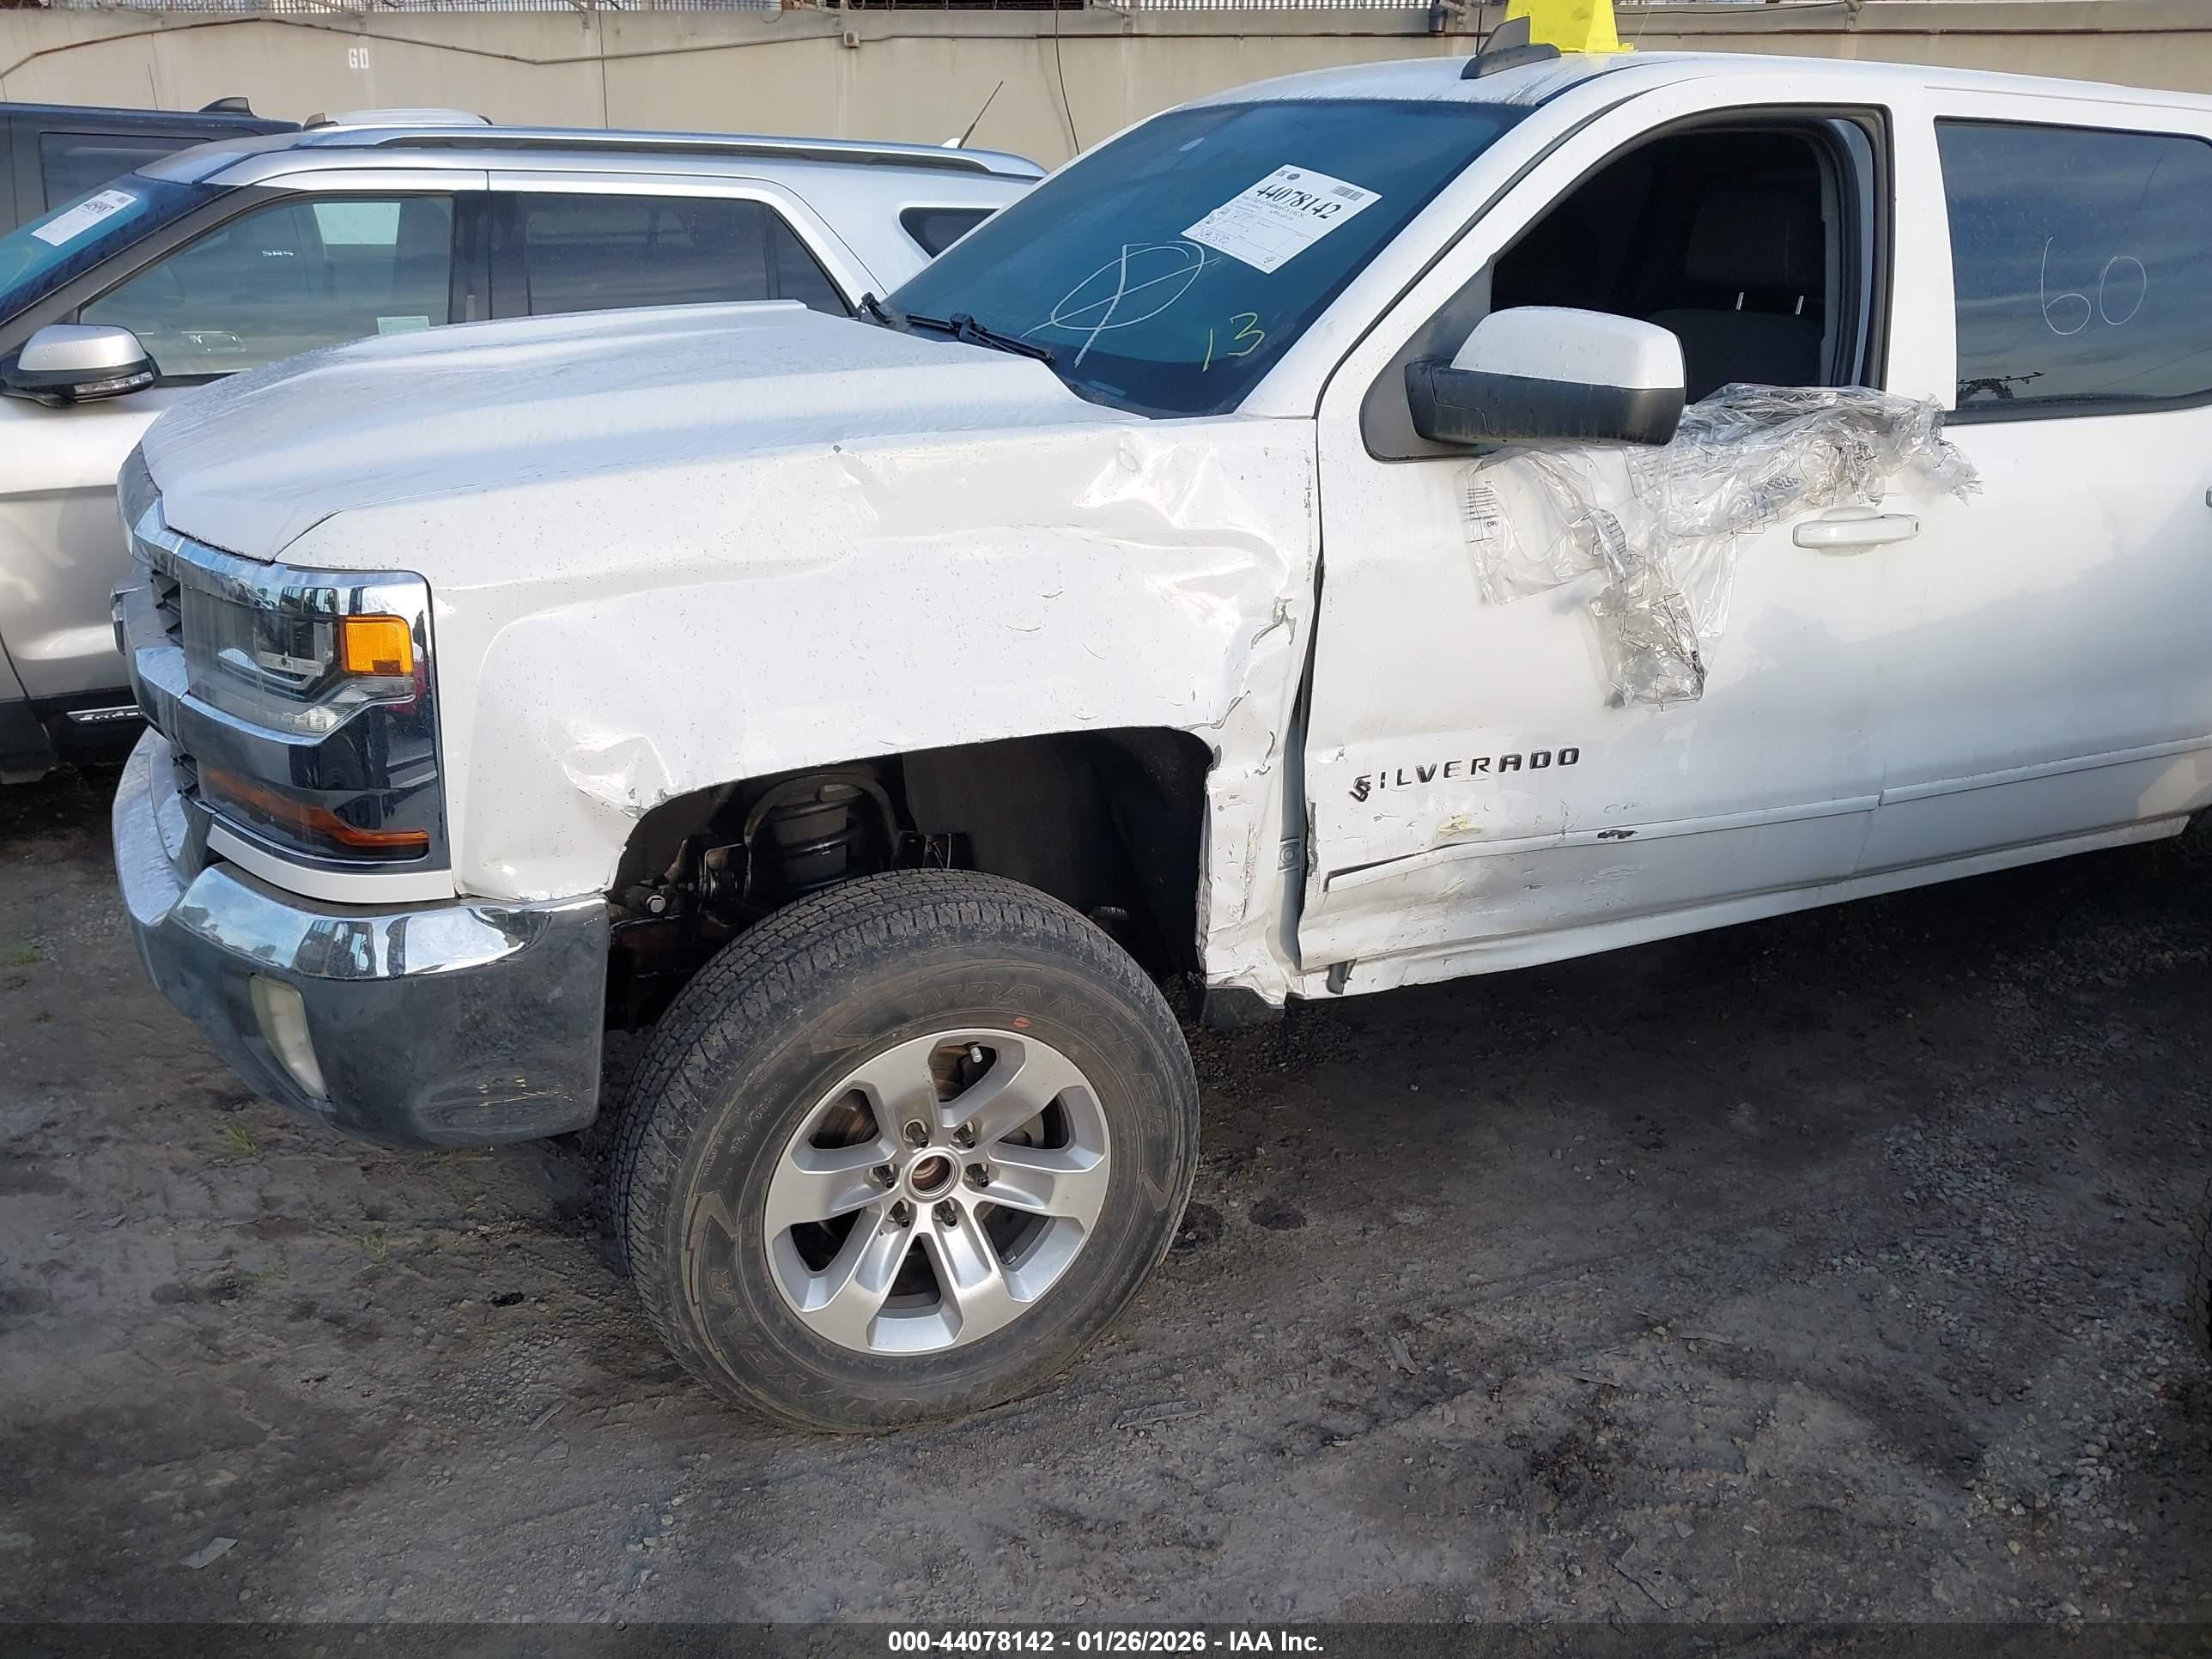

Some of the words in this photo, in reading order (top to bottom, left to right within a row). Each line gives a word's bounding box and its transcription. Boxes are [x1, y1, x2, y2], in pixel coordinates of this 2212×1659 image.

[1256, 183, 1342, 220] 44078142
[2041, 236, 2147, 335] 60
[1202, 312, 1266, 372] 13
[1348, 746, 1580, 803] SILVERADO
